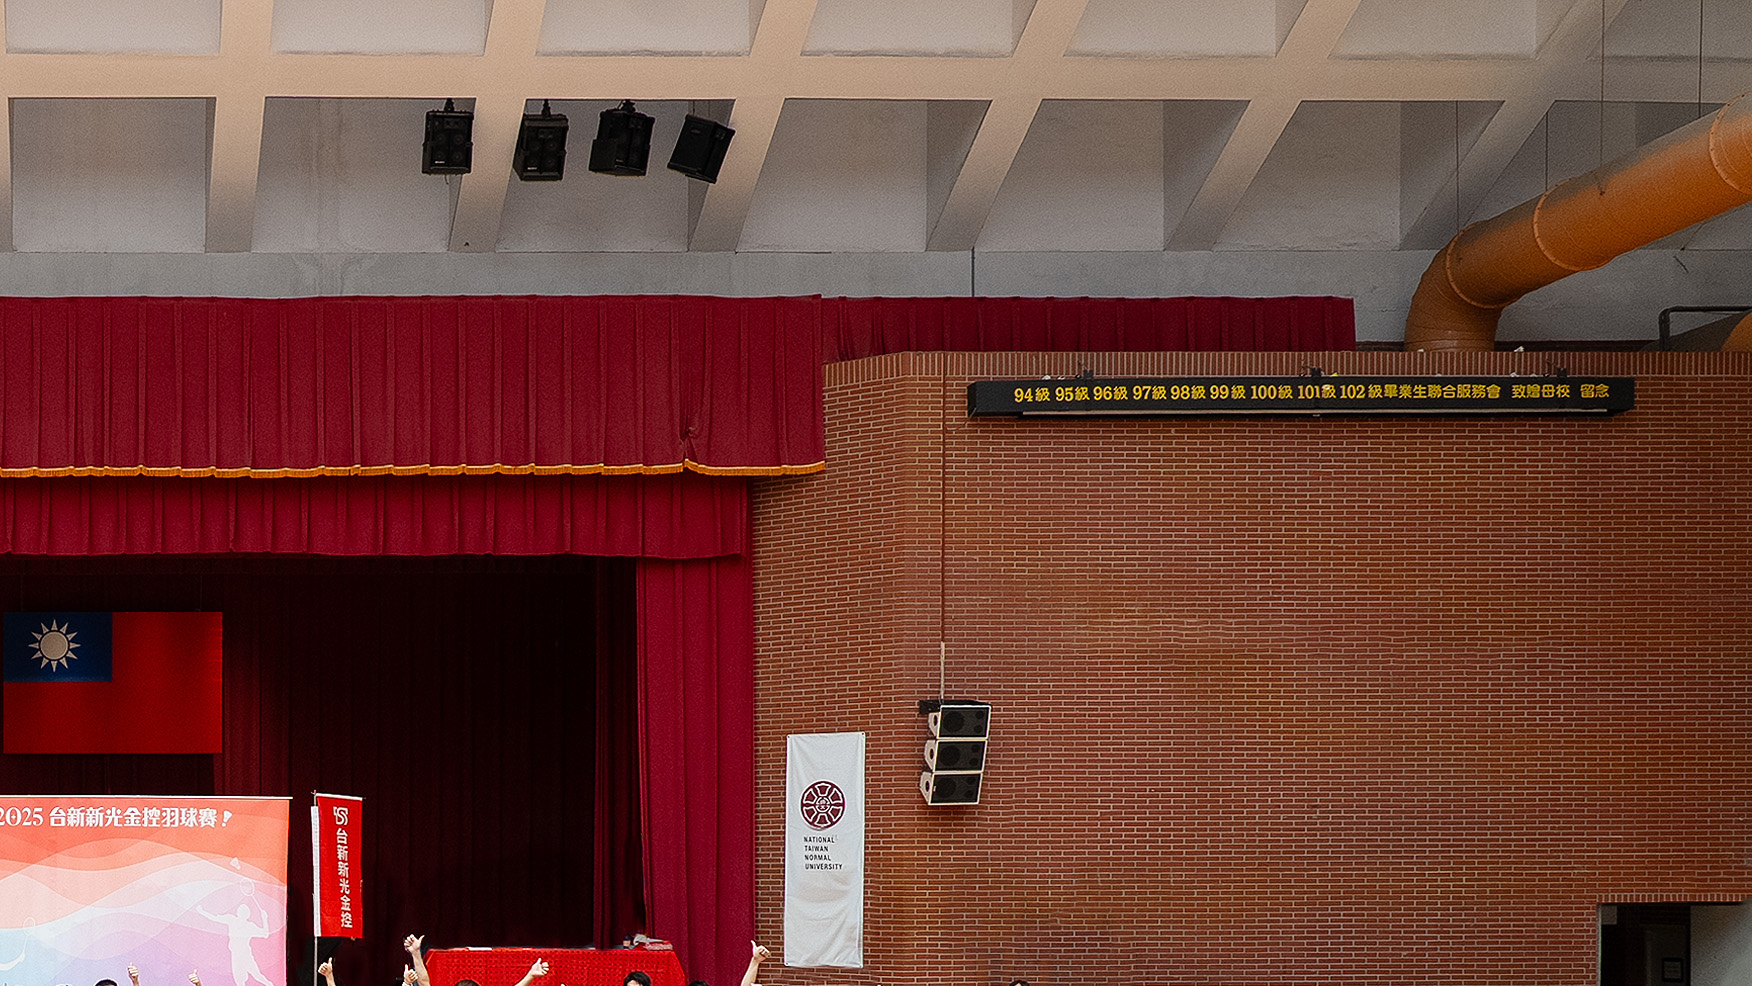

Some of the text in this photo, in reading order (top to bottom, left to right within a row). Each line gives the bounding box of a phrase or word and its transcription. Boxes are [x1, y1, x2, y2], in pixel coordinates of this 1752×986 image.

[1014, 387, 1051, 403] 94級
[1055, 386, 1090, 402] 95級
[1093, 385, 1128, 401] 96級
[1132, 385, 1167, 400] 97級
[1171, 385, 1206, 400] 98級
[1210, 385, 1246, 400] 99級
[1251, 384, 1293, 400] 100級
[1580, 384, 1610, 398] 留念
[334, 828, 353, 929] 台新新光金控
